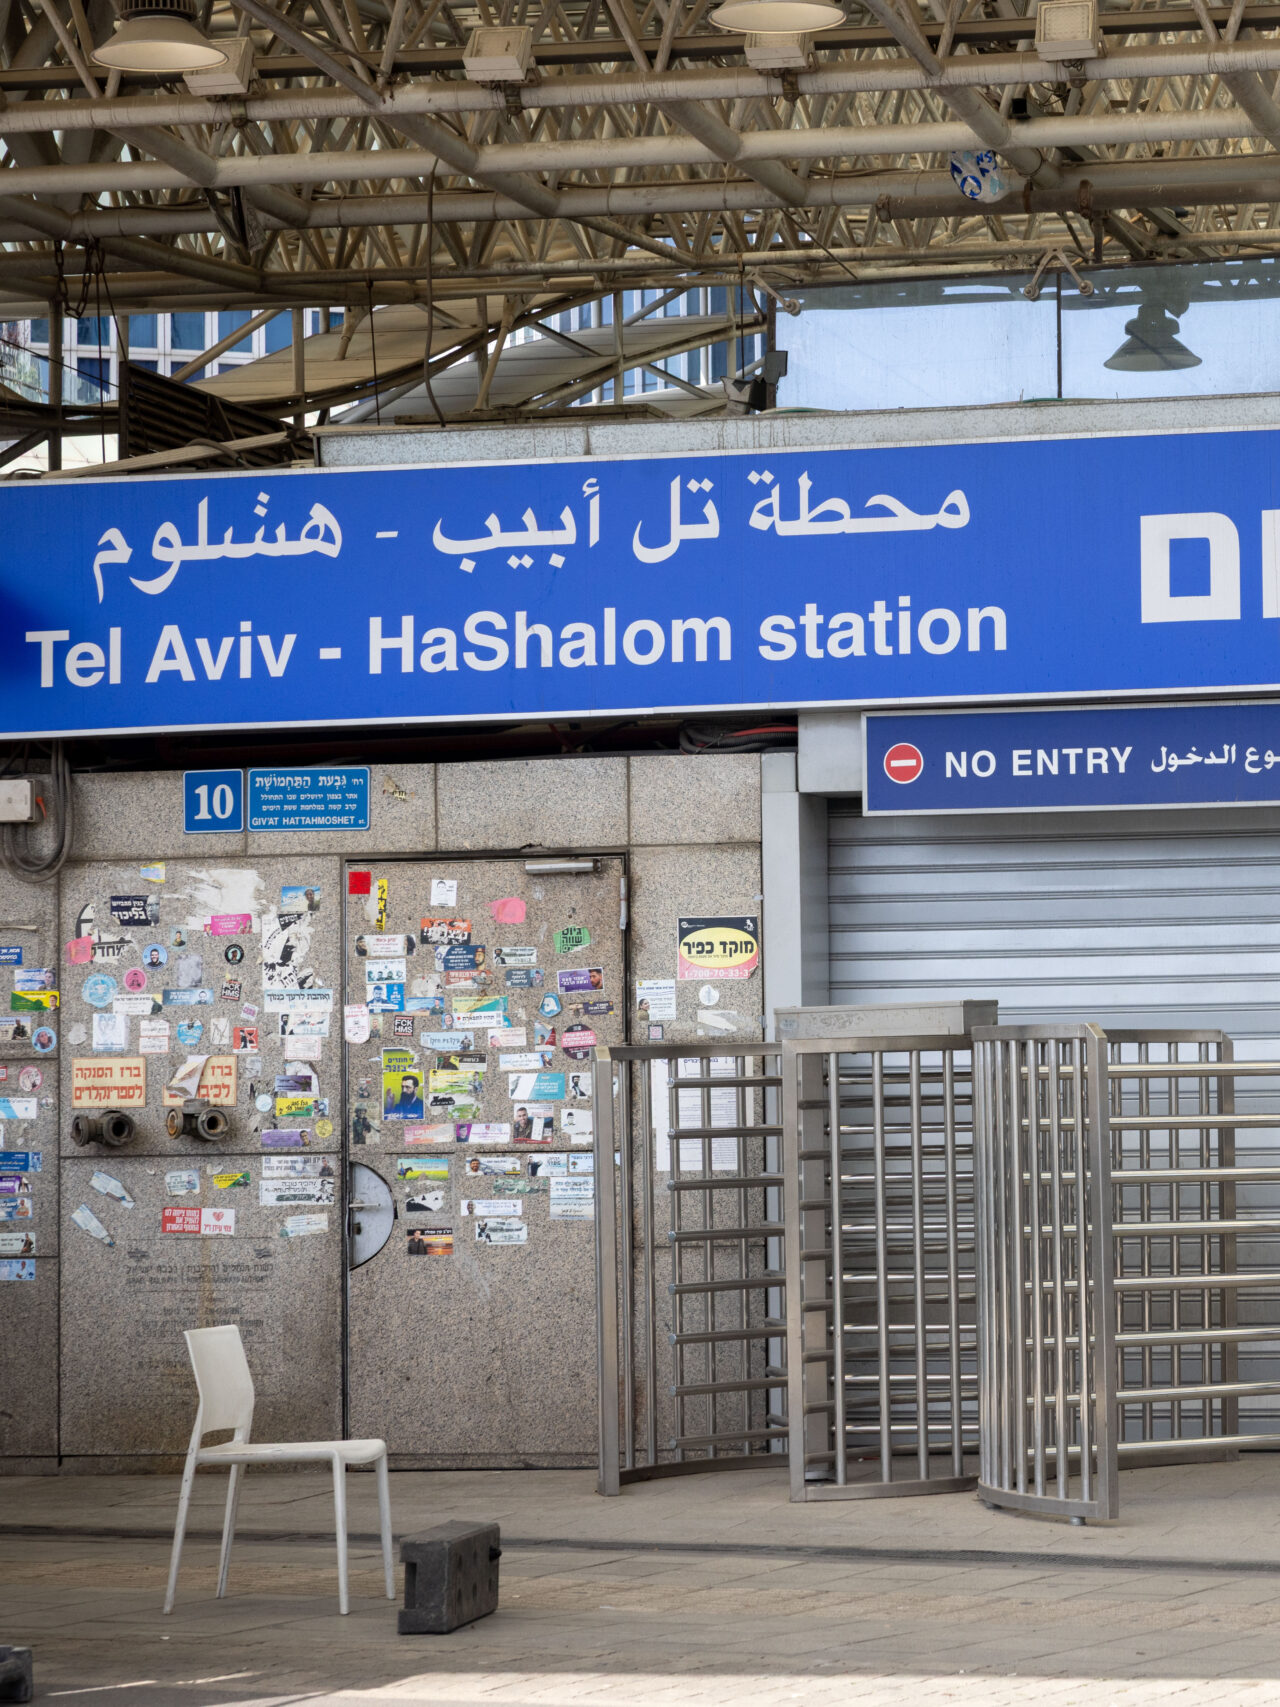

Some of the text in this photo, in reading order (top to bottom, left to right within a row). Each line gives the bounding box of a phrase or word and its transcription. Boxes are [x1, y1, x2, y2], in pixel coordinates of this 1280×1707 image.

[748, 470, 970, 536] محطة
[433, 478, 599, 573] أبيب
[633, 475, 719, 563] تل
[94, 492, 342, 602] هشلوم
[26, 596, 1006, 687] Tel Aviv - HaShalom station
[946, 747, 1132, 777] NO ENTRY
[1151, 744, 1236, 772] الدخول
[194, 784, 234, 820] 10
[282, 816, 355, 826] HATTAHMOSHET
[683, 941, 754, 957] מוקד כפיר
[685, 968, 751, 978] 1-700-70-33-3
[267, 992, 330, 1002] ואהבת לרעך כמוך
[394, 1026, 413, 1034] HMS
[395, 1019, 413, 1027] FCK
[75, 1066, 141, 1080] ברז הסנקה
[211, 1065, 233, 1076] ברז
